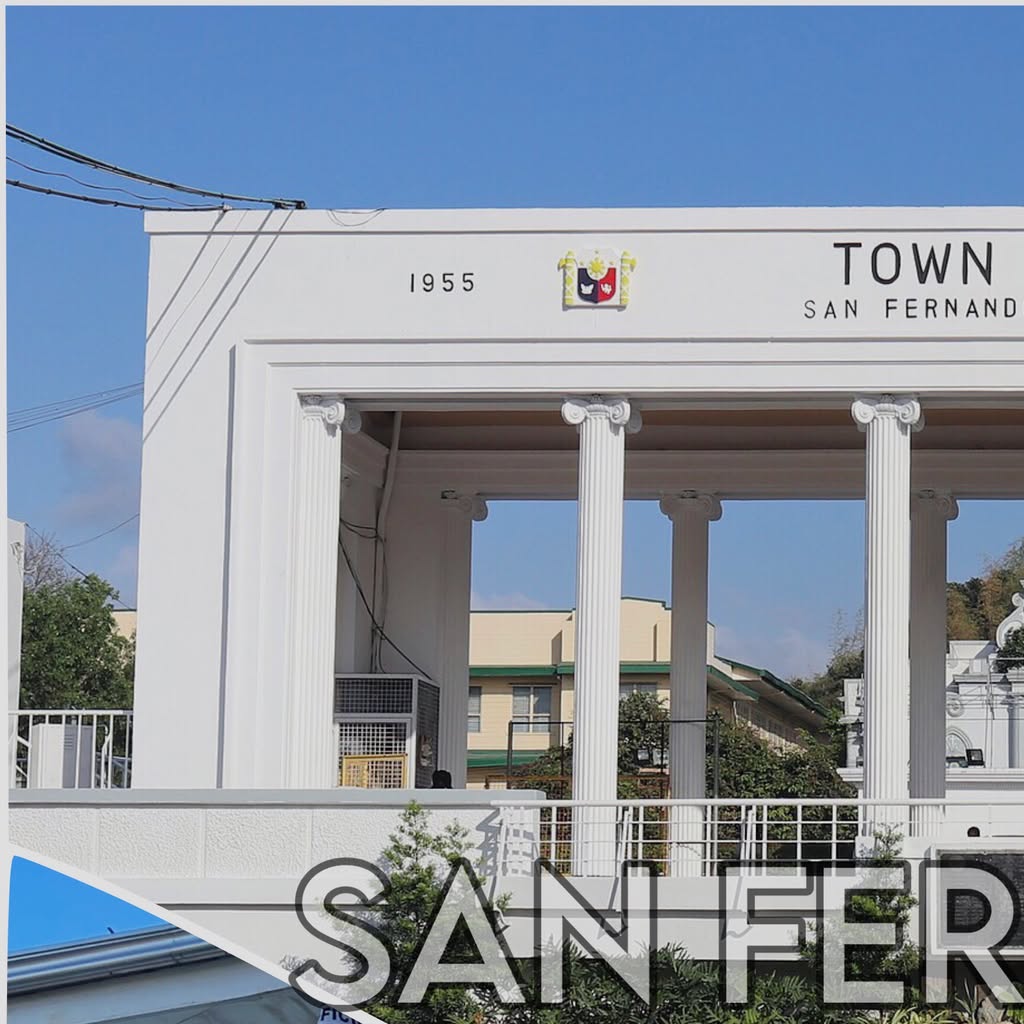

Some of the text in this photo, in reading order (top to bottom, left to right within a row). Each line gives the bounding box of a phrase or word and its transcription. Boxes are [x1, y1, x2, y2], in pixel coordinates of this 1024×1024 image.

[834, 242, 992, 284] TOWN
[409, 273, 474, 292] 1955
[804, 300, 858, 319] SAN
